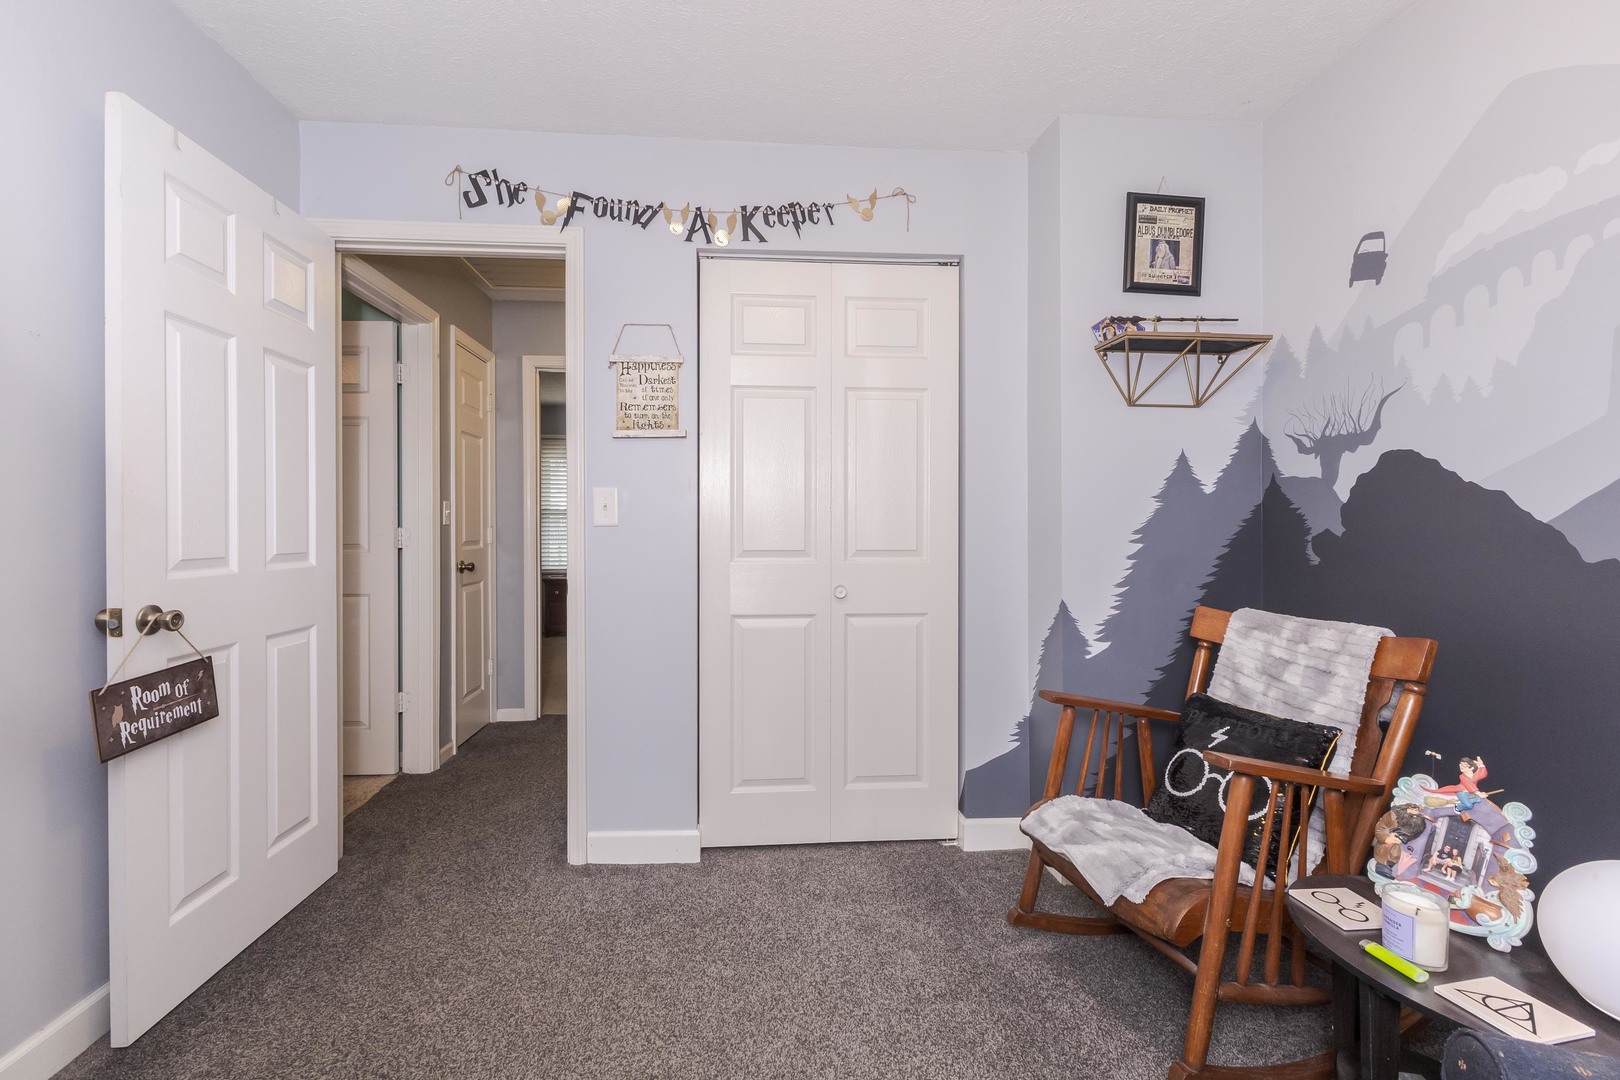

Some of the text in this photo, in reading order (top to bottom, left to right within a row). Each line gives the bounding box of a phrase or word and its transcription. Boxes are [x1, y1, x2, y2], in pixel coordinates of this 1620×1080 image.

[463, 168, 835, 244] She Found A Keeper
[1149, 205, 1194, 215] DAILY PROPHET
[1137, 225, 1156, 236] ALBUS
[1157, 226, 1194, 239] DUMBLEDORE
[619, 361, 677, 377] Happiness
[639, 374, 676, 386] Darkest
[650, 385, 674, 393] times
[130, 678, 190, 715] Room of
[119, 697, 203, 750] Requirement
